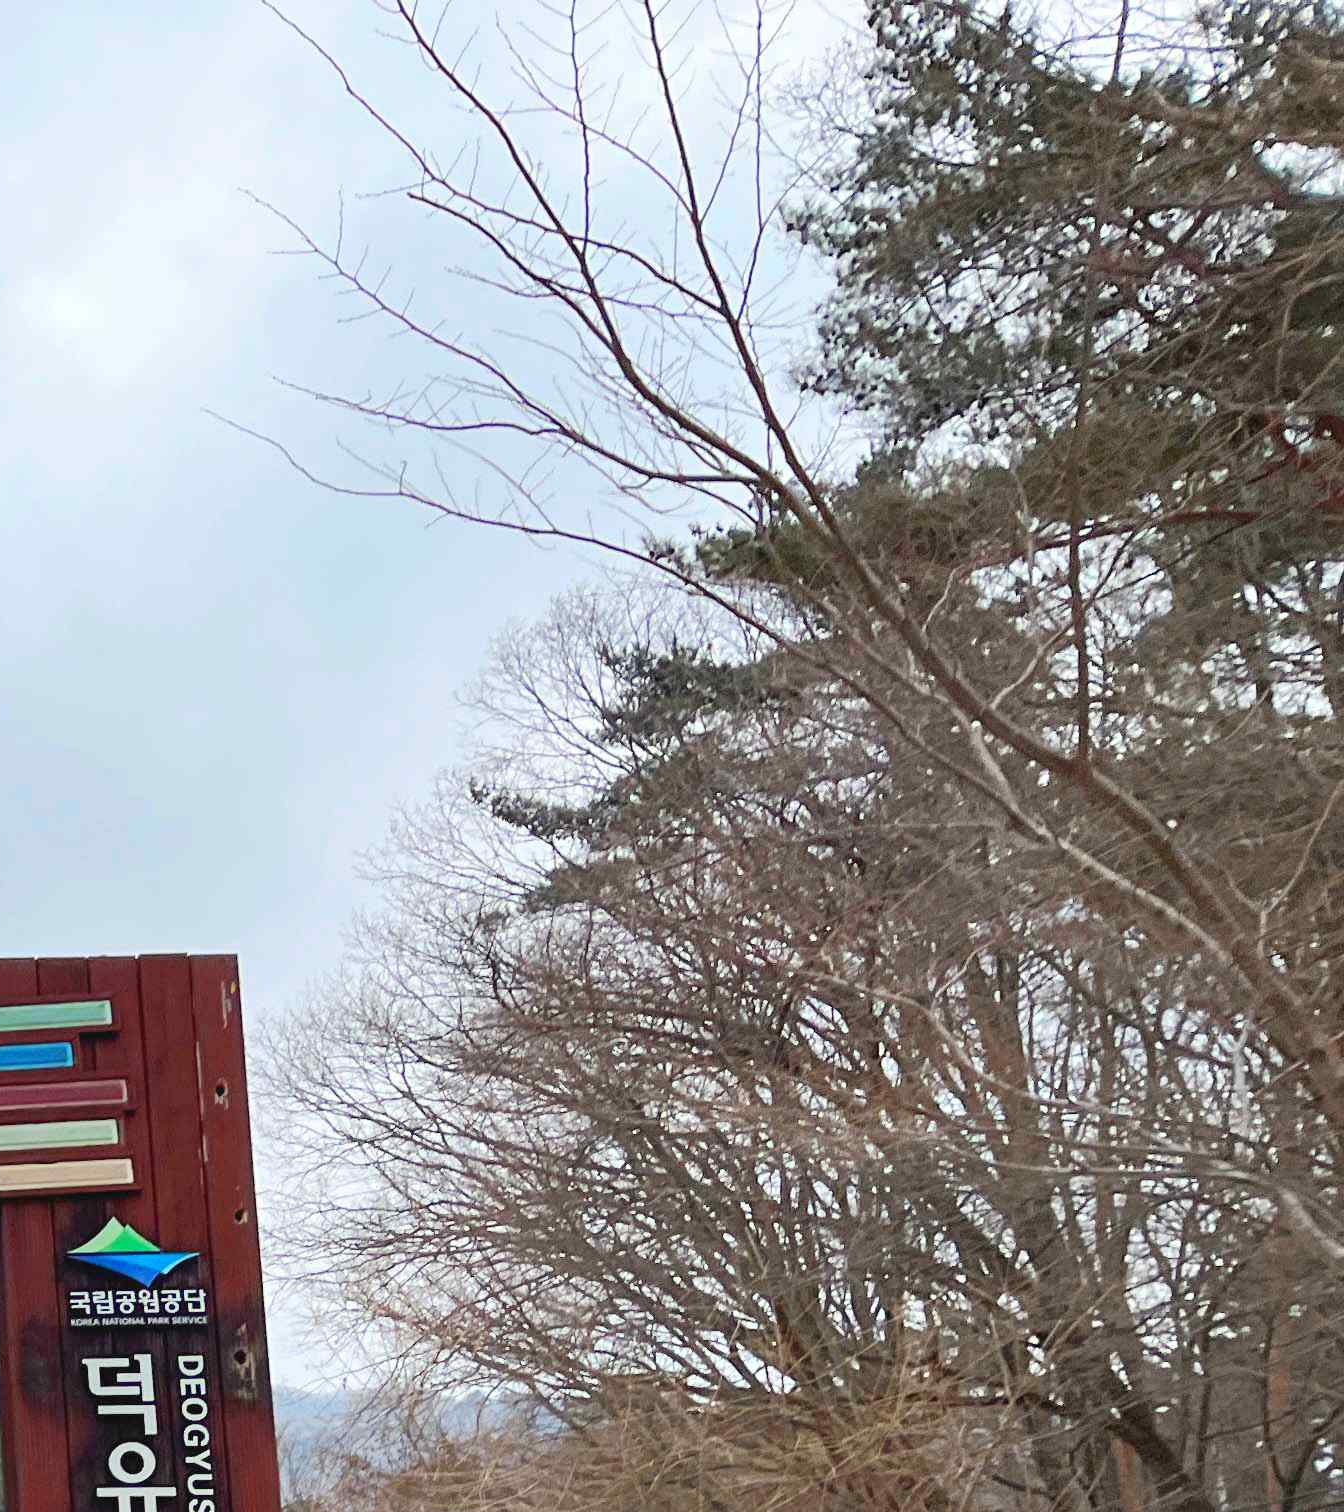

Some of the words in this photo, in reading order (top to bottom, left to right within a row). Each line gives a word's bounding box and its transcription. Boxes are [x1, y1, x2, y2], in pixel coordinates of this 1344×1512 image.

[69, 1288, 207, 1315] 국립공원공단
[70, 1318, 100, 1327] KOREA
[101, 1317, 146, 1326] NATIONAL
[147, 1316, 170, 1325] PARK
[171, 1315, 208, 1325] SERVICE
